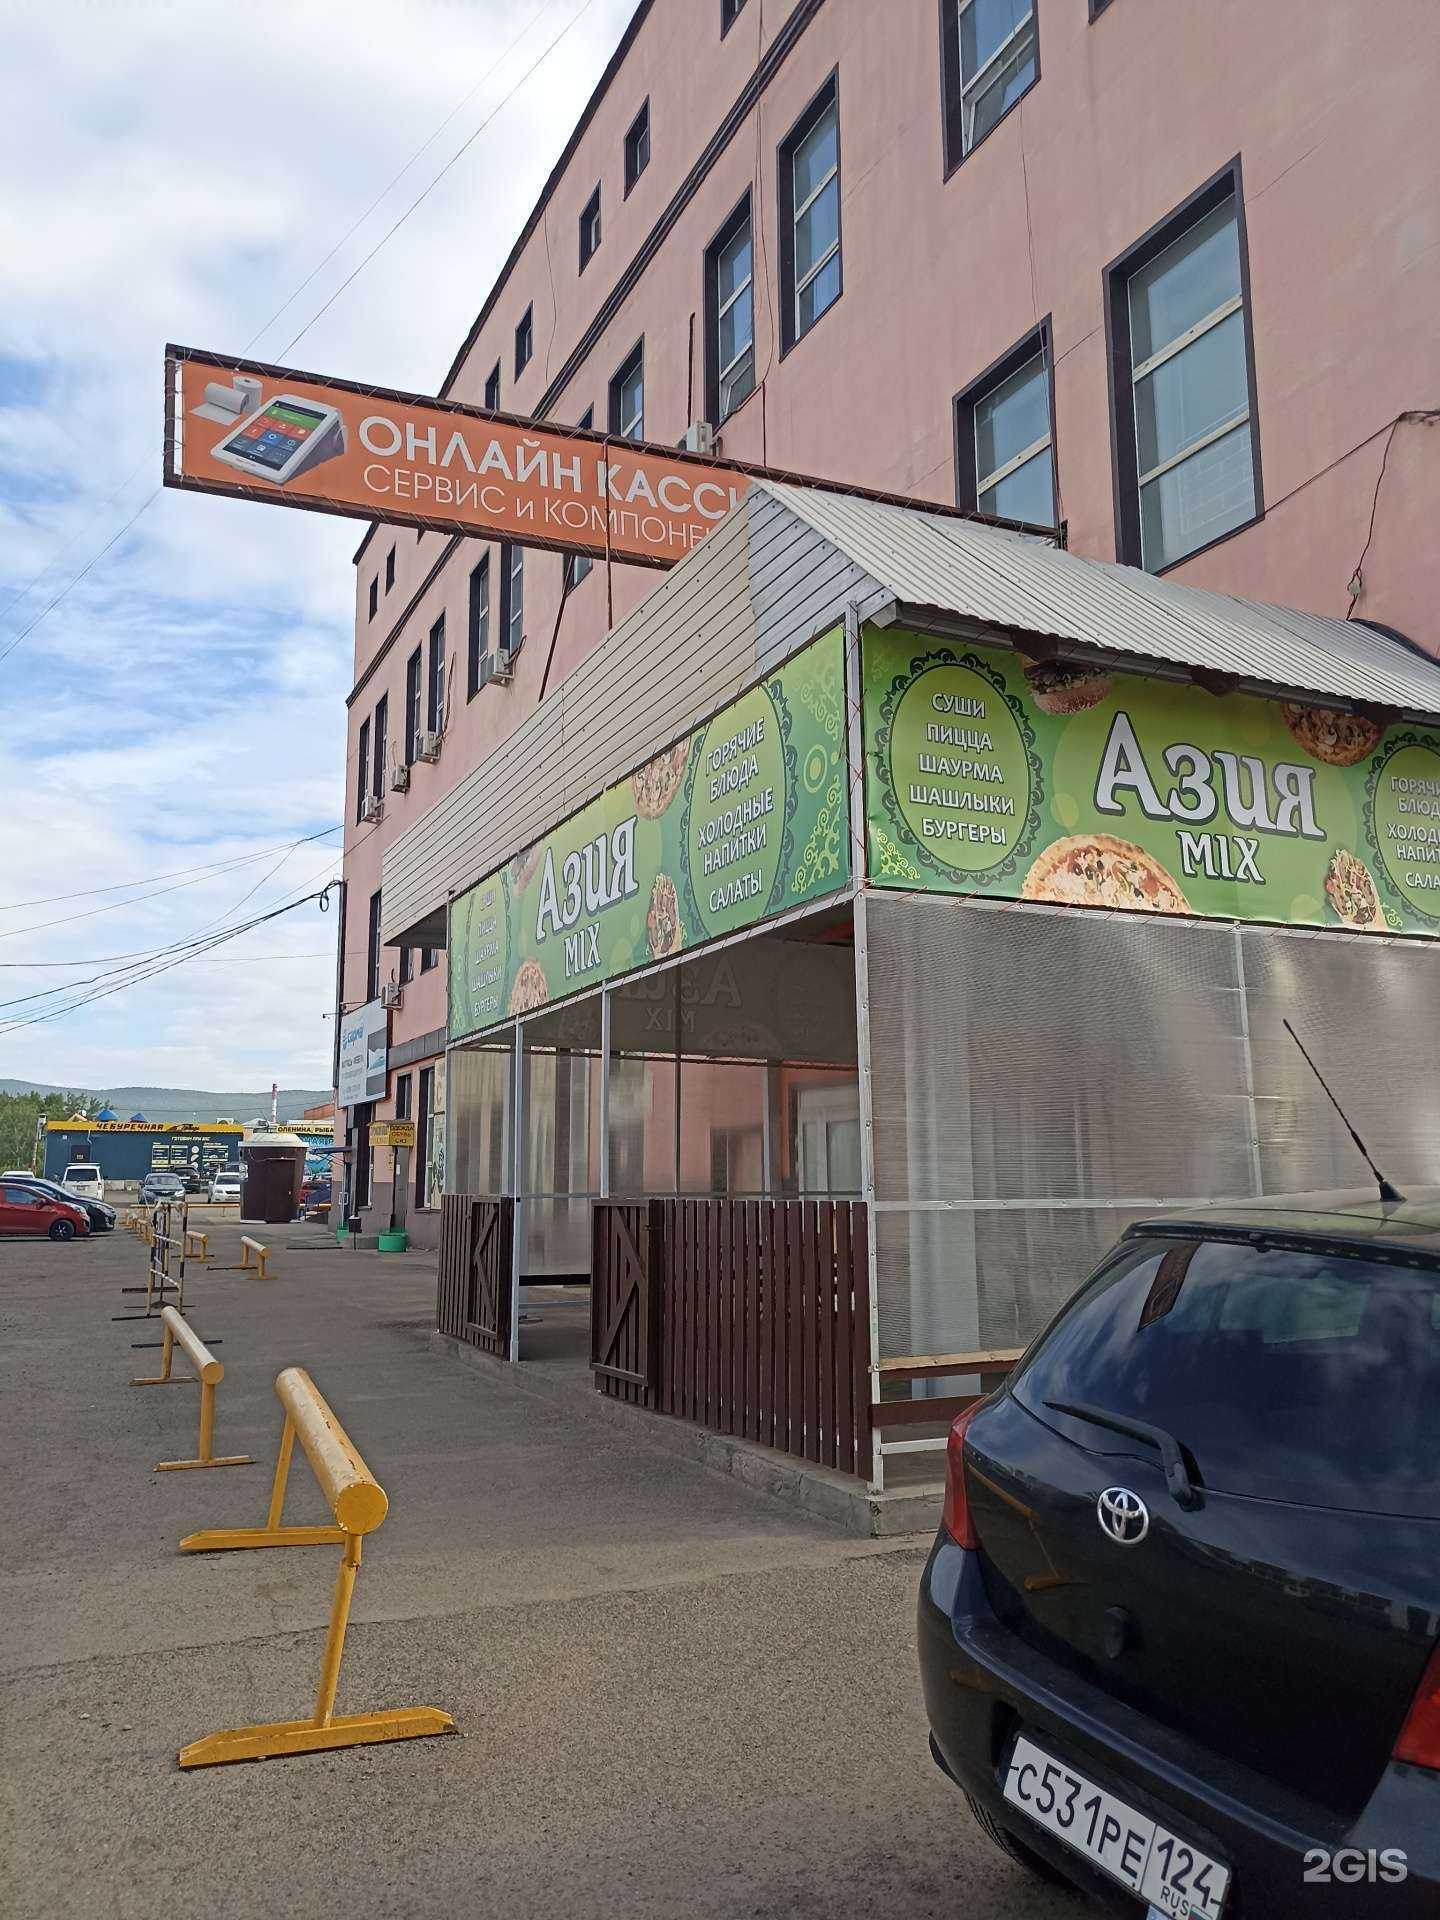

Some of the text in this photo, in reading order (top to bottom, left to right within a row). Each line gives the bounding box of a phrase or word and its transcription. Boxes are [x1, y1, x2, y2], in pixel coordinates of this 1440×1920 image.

[359, 415, 581, 493] ОНЛАЙН
[363, 464, 505, 515] СЕРВИС
[545, 497, 709, 550] КОМПОНЕ
[931, 693, 986, 719] СУШИ
[706, 717, 765, 774] ГОРЯЧИЕ
[926, 723, 993, 752] ПИЦЦА
[709, 755, 759, 803] БЛЮДА
[919, 755, 1004, 784] ШАУРМА
[909, 784, 1015, 816] ШАШЛЫКИ
[1398, 798, 1440, 819] БЛЮД
[697, 788, 774, 849] ХОЛОДНЫЕ
[922, 818, 1007, 846] БУРГЕРЫ
[1387, 823, 1440, 845] ХОЛОД
[703, 824, 767, 876] НАПИТКИ
[1177, 831, 1266, 884] MIX
[1396, 845, 1440, 863] НАПИТ
[709, 870, 763, 912] САЛАТЫ
[1405, 872, 1440, 888] САЛА
[564, 923, 601, 978] MIX
[96, 1122, 164, 1131] ЧЕБУРЕЧНАЯ
[1017, 1762, 1213, 1909] С531РЕ 124
[1160, 1885, 1190, 1917] RUS
